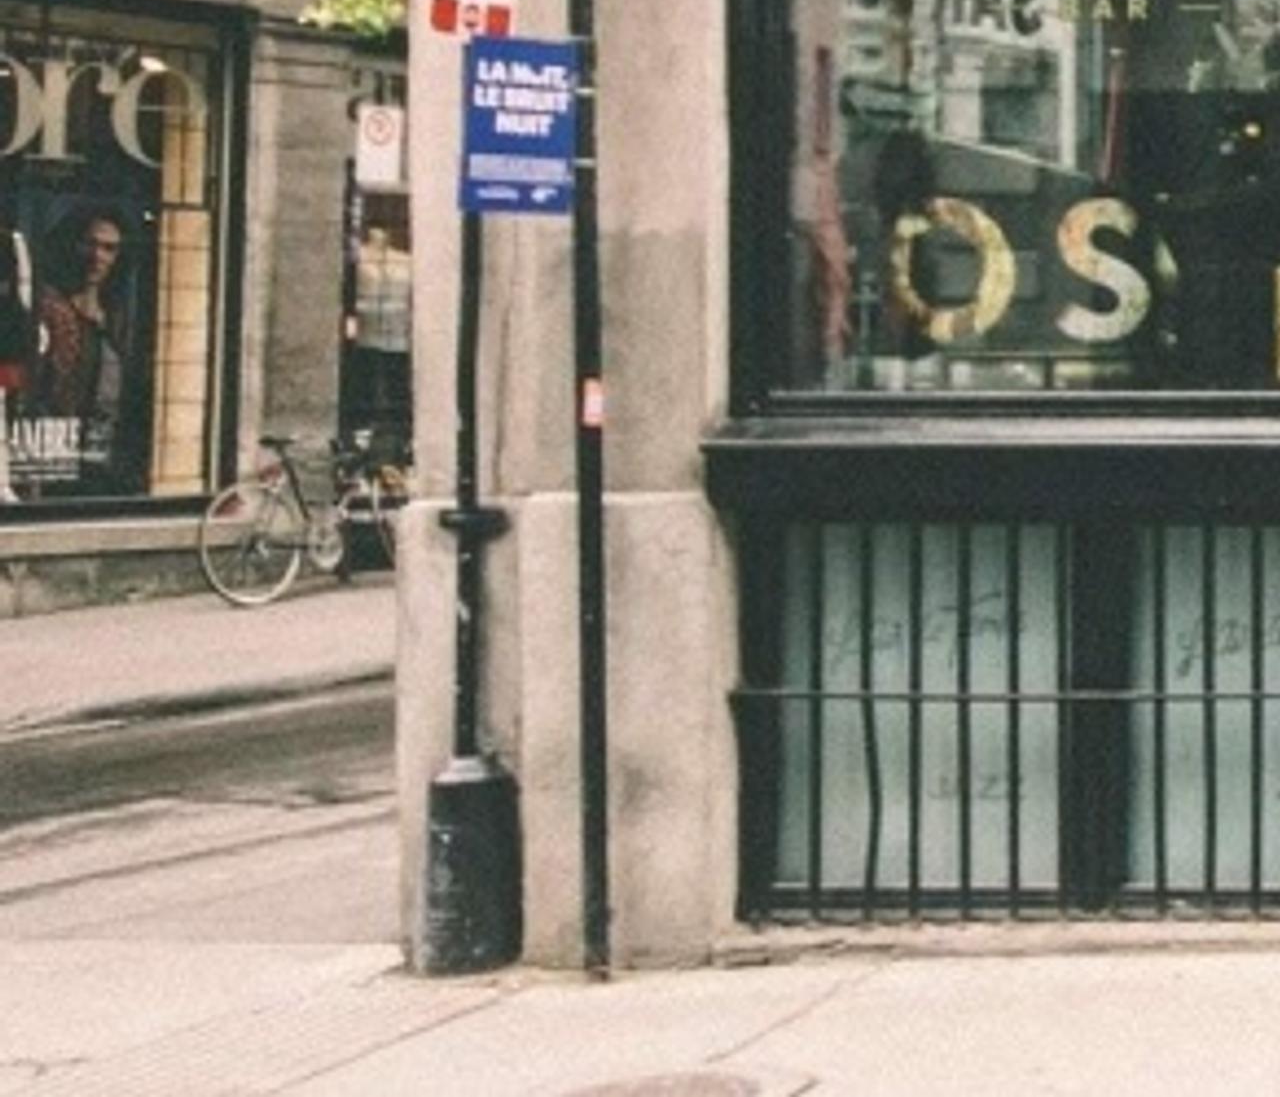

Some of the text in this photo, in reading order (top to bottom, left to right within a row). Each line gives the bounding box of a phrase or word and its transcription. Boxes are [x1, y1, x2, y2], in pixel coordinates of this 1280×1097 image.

[477, 59, 507, 82] LA
[474, 84, 500, 108] LE
[496, 112, 554, 137] NUIT
